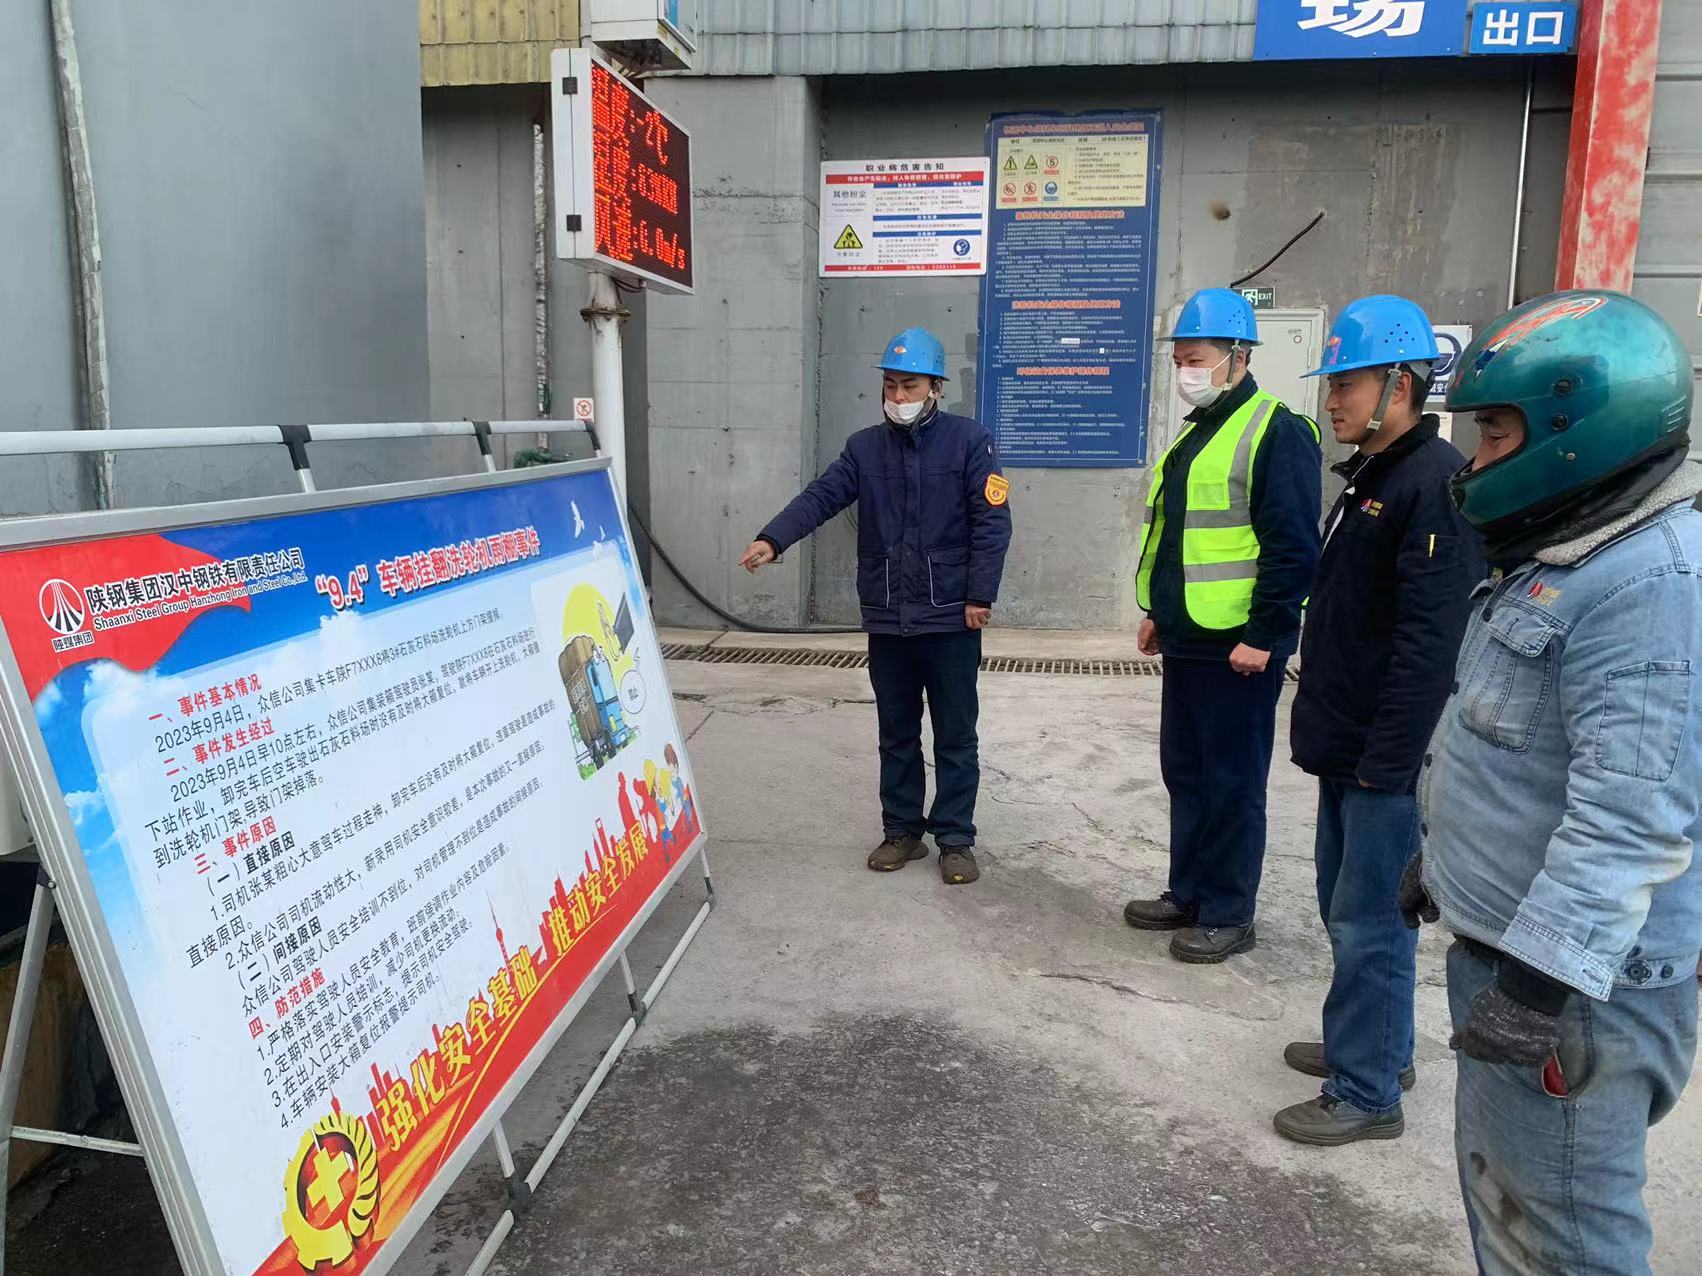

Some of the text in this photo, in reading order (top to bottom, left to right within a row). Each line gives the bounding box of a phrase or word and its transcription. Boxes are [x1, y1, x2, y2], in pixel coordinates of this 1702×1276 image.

[1483, 9, 1564, 46] 出口
[1049, 158, 1056, 166] 5
[1258, 292, 1273, 300] EXIT
[85, 547, 305, 616] 陕钢集团汉中钢铁有限责任公司
[377, 526, 541, 597] 车辆挂翻洗轮机雨棚事件
[94, 609, 135, 631] Shaanxi
[136, 604, 161, 622] Steel
[162, 599, 190, 617] Group
[190, 589, 232, 609] Hanzhong
[231, 586, 249, 599] Iron
[249, 583, 263, 595] and
[264, 577, 282, 592] Steel
[149, 673, 263, 722] 一、事件基本情况
[164, 716, 275, 776] 二、事件发生经过
[194, 815, 277, 875] 三、事件原因
[207, 830, 296, 897] （一）直接原因
[186, 914, 253, 969] 直接原因。
[238, 915, 323, 990] （二）间接原因
[248, 967, 326, 1040] 四、防范措施
[376, 821, 649, 1152] 强化安全基础 推动安全发展
[281, 971, 440, 1129] 4.车辆安装大箱复位报警提示司机。
